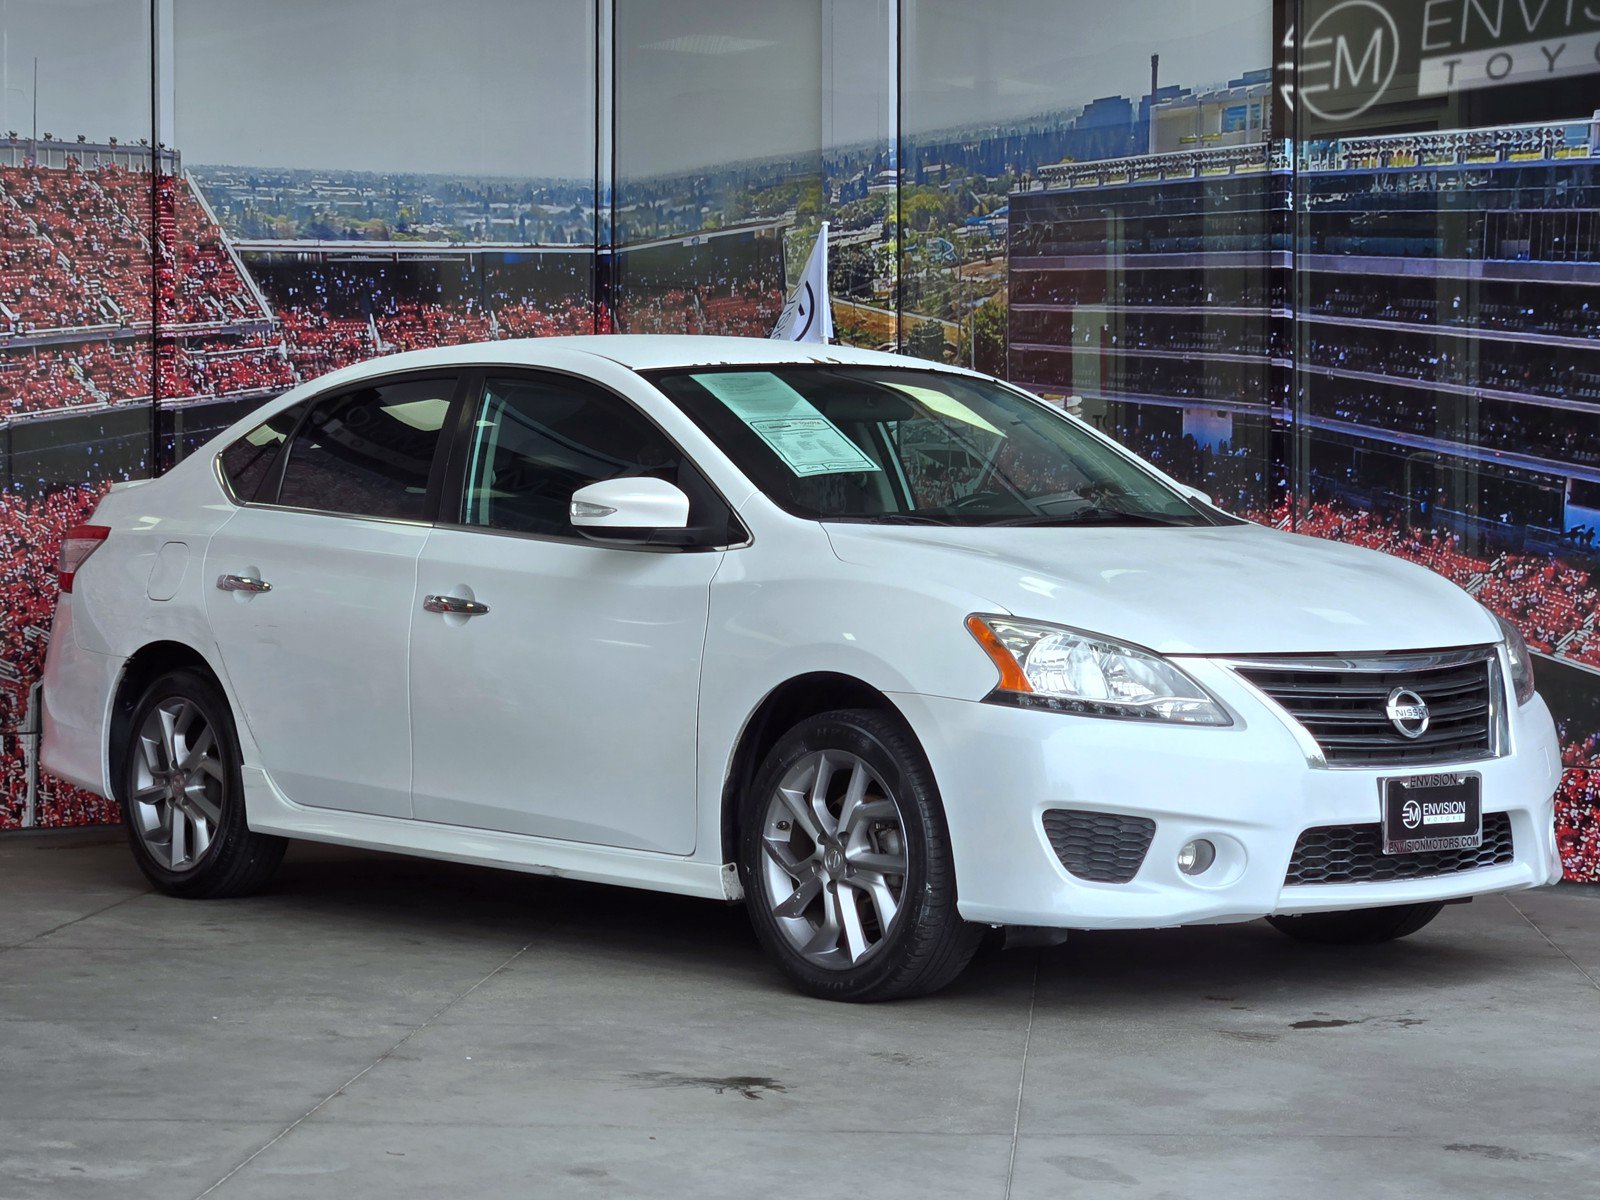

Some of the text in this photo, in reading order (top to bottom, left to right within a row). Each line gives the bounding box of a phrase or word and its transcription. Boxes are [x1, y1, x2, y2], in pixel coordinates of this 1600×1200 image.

[1422, 0, 1600, 50] ENVI
[1443, 43, 1600, 86] TOY
[1410, 773, 1457, 788] ENVISION
[1423, 801, 1465, 815] ENVISION
[1388, 836, 1479, 853] ENVISIONMOTORS.COM
